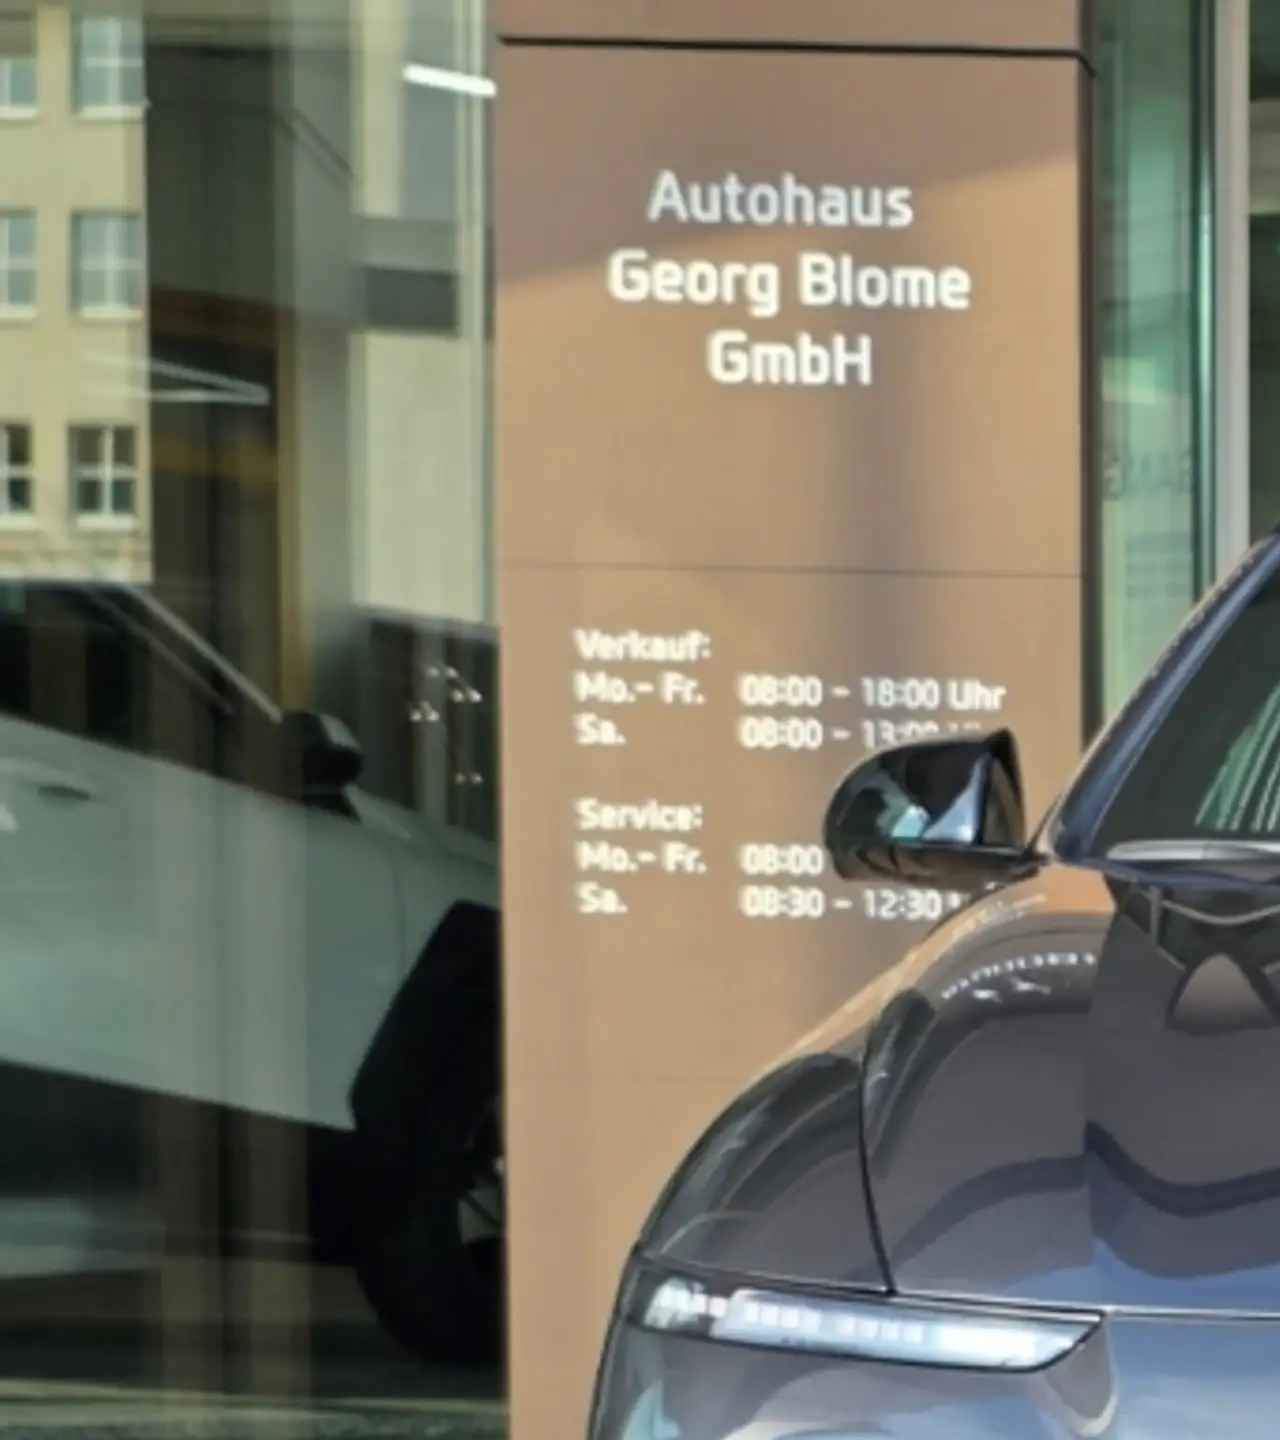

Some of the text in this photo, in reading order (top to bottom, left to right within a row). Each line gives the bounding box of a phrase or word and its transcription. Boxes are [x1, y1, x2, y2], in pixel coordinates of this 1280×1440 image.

[647, 170, 913, 227] Autohaus
[607, 248, 972, 317] Georg Blome
[708, 329, 872, 385] GmbH
[574, 628, 711, 662] Verkauf:
[661, 670, 705, 704] Fr.
[740, 674, 822, 708] 08:00
[862, 677, 939, 709] 18:00
[947, 678, 1005, 710] Uhr
[574, 712, 626, 745] Sa.
[740, 716, 822, 749] 08:00
[575, 797, 703, 831] Service:
[662, 840, 706, 873] Fr.
[740, 844, 824, 876] 08:00
[575, 881, 628, 914] Sa.
[740, 885, 824, 918] 08:30
[864, 889, 943, 919] 12:30
